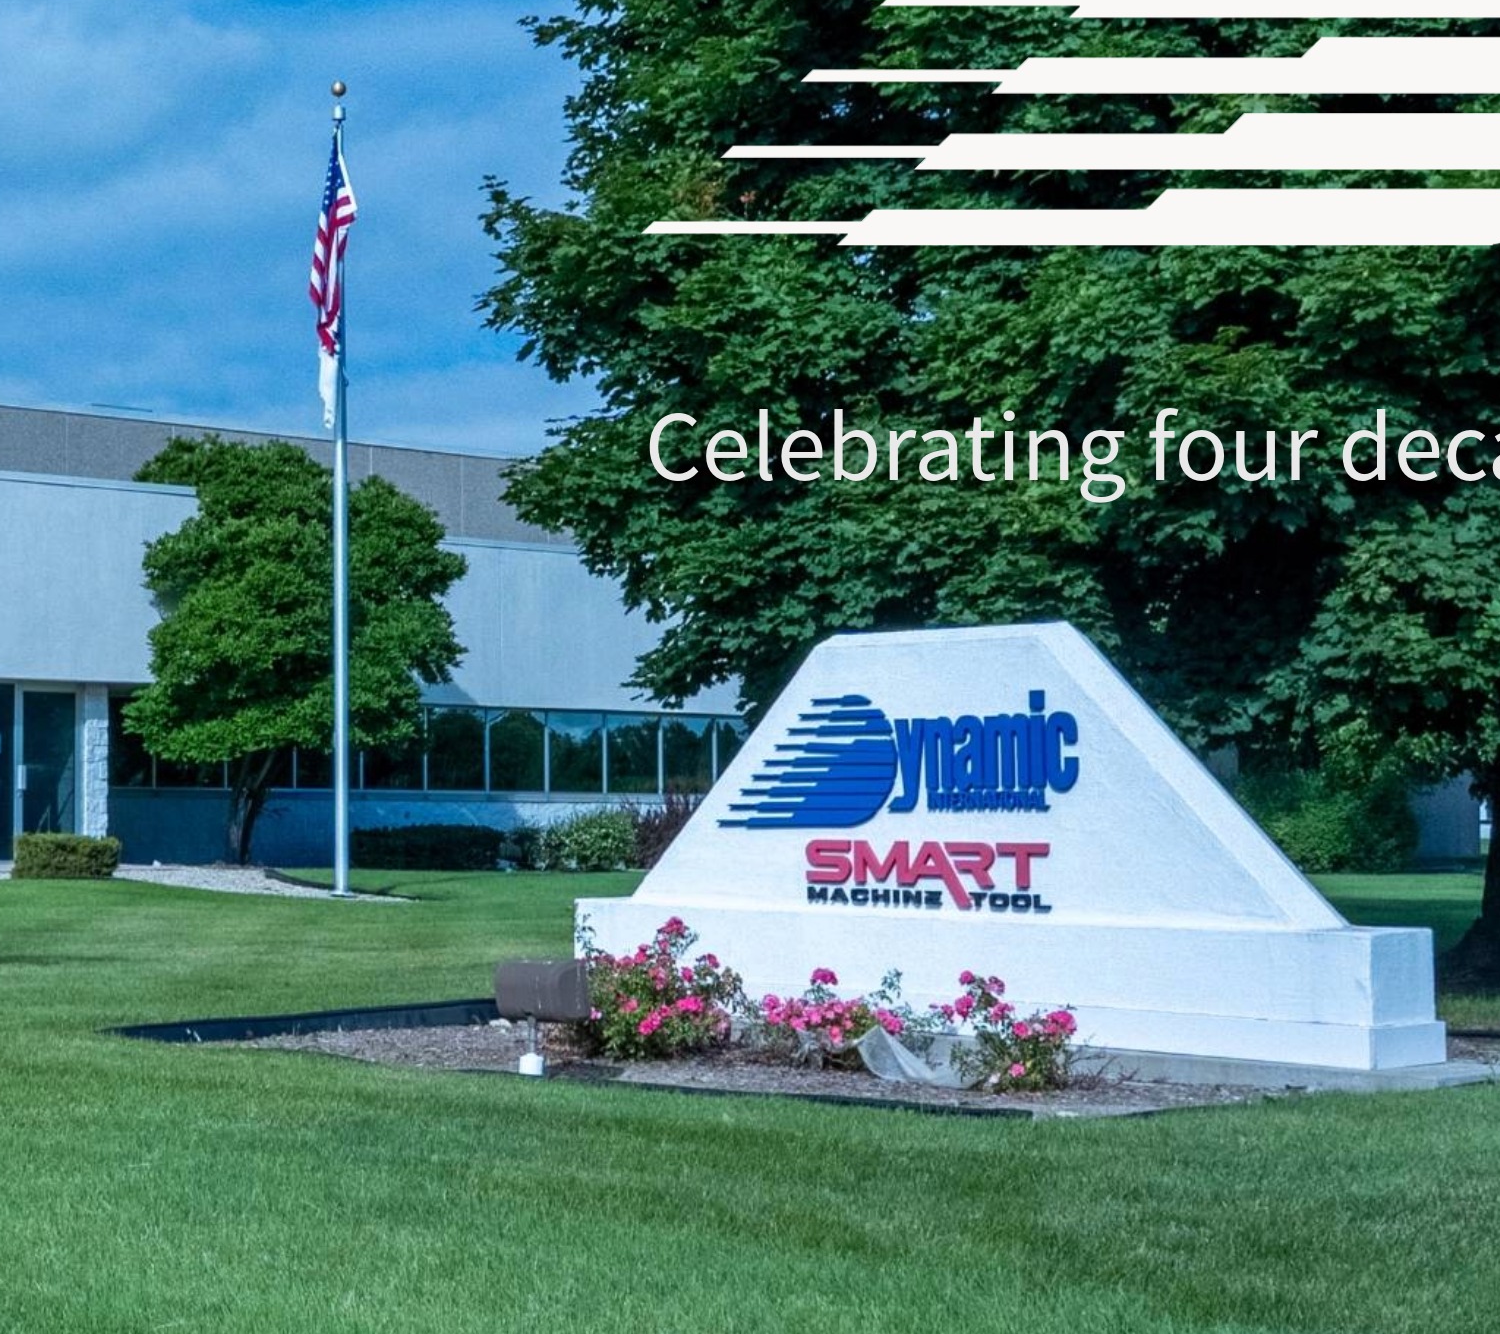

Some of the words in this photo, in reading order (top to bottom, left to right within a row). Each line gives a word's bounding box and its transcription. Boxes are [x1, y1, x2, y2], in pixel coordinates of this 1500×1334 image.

[927, 790, 1051, 814] INTERNATIONAL
[805, 839, 1051, 910] SMART
[806, 885, 943, 909] MACHINE
[968, 891, 1053, 913] TOOL
